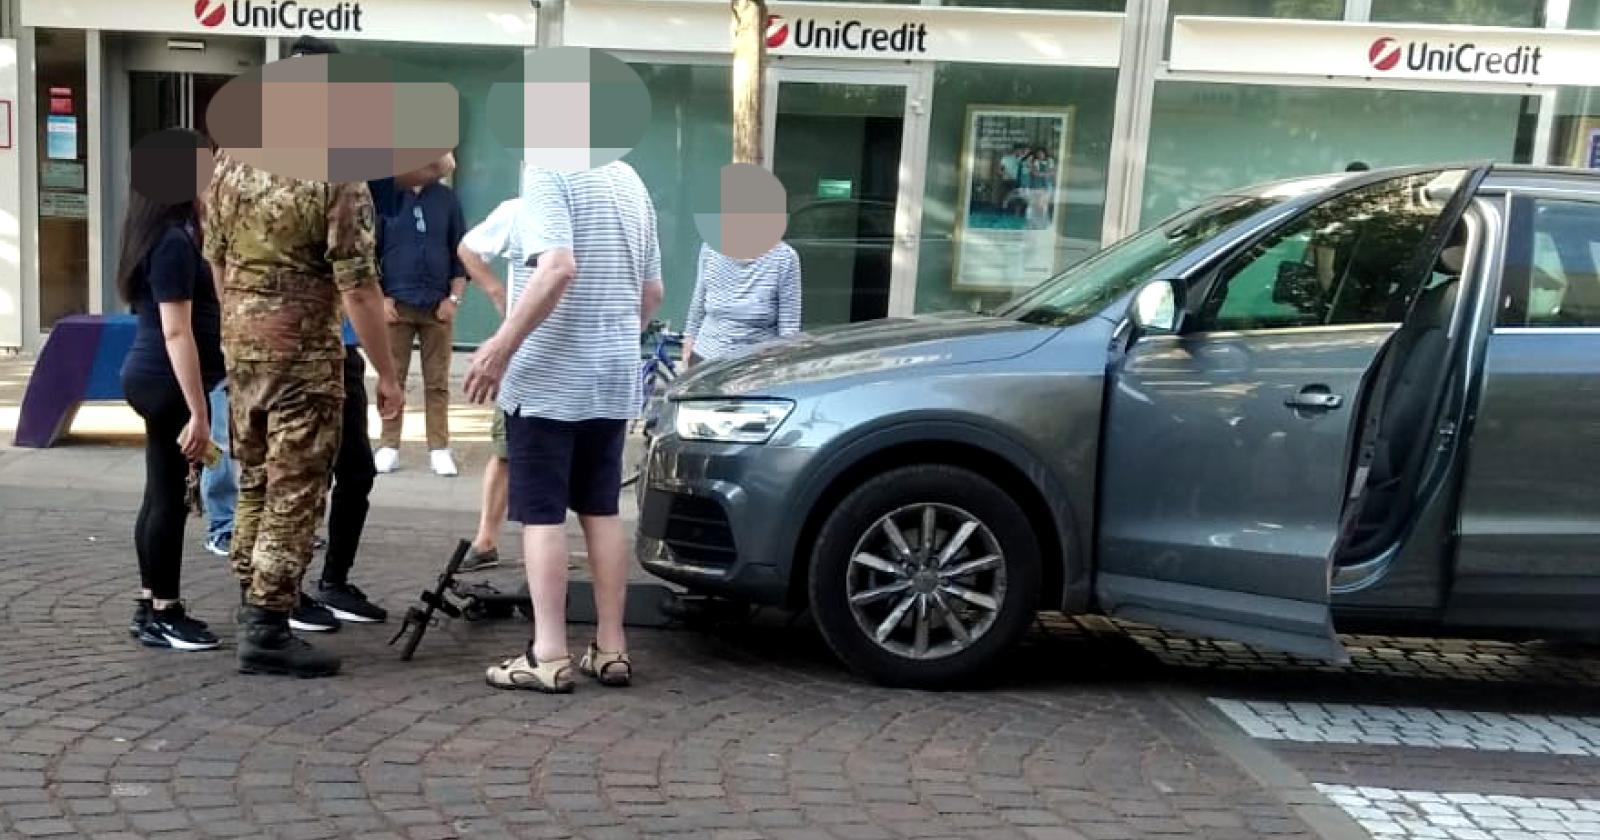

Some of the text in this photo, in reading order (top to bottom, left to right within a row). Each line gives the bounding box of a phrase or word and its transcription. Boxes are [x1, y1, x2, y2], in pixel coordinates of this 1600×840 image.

[232, 0, 362, 31] UniCredit
[794, 19, 927, 52] UniCredit
[1407, 42, 1542, 75] UniCredit
